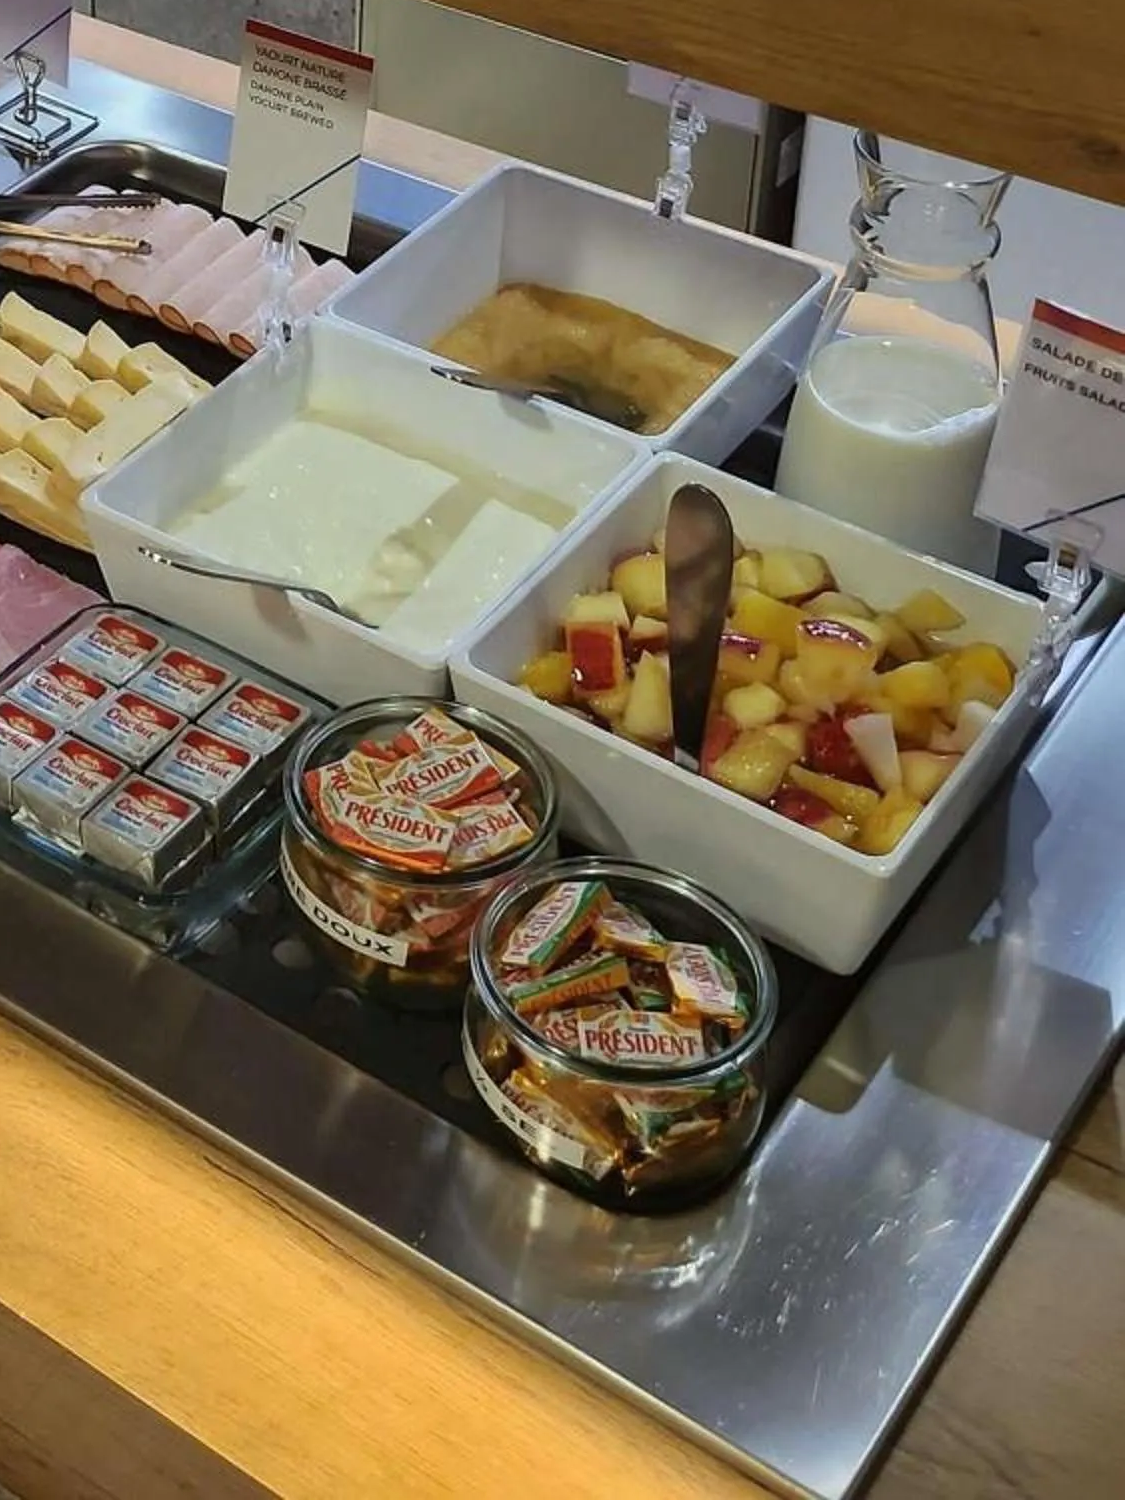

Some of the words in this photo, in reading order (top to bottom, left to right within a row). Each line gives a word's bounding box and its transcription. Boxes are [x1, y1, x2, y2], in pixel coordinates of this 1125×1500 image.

[252, 61, 303, 87] DANONE
[255, 44, 300, 68] YAOURT
[300, 60, 346, 83] NATURE
[250, 79, 293, 102] DANONE
[294, 95, 325, 113] PLAIN
[1023, 362, 1076, 392] FRUITS
[1031, 337, 1095, 374] SALADE
[1100, 366, 1124, 385] DE
[384, 747, 481, 796] PRÉSIDENT
[343, 800, 446, 845] PRÉSIDENT
[313, 906, 394, 958] DOUX
[583, 1027, 698, 1061] PRÉSIDENT
